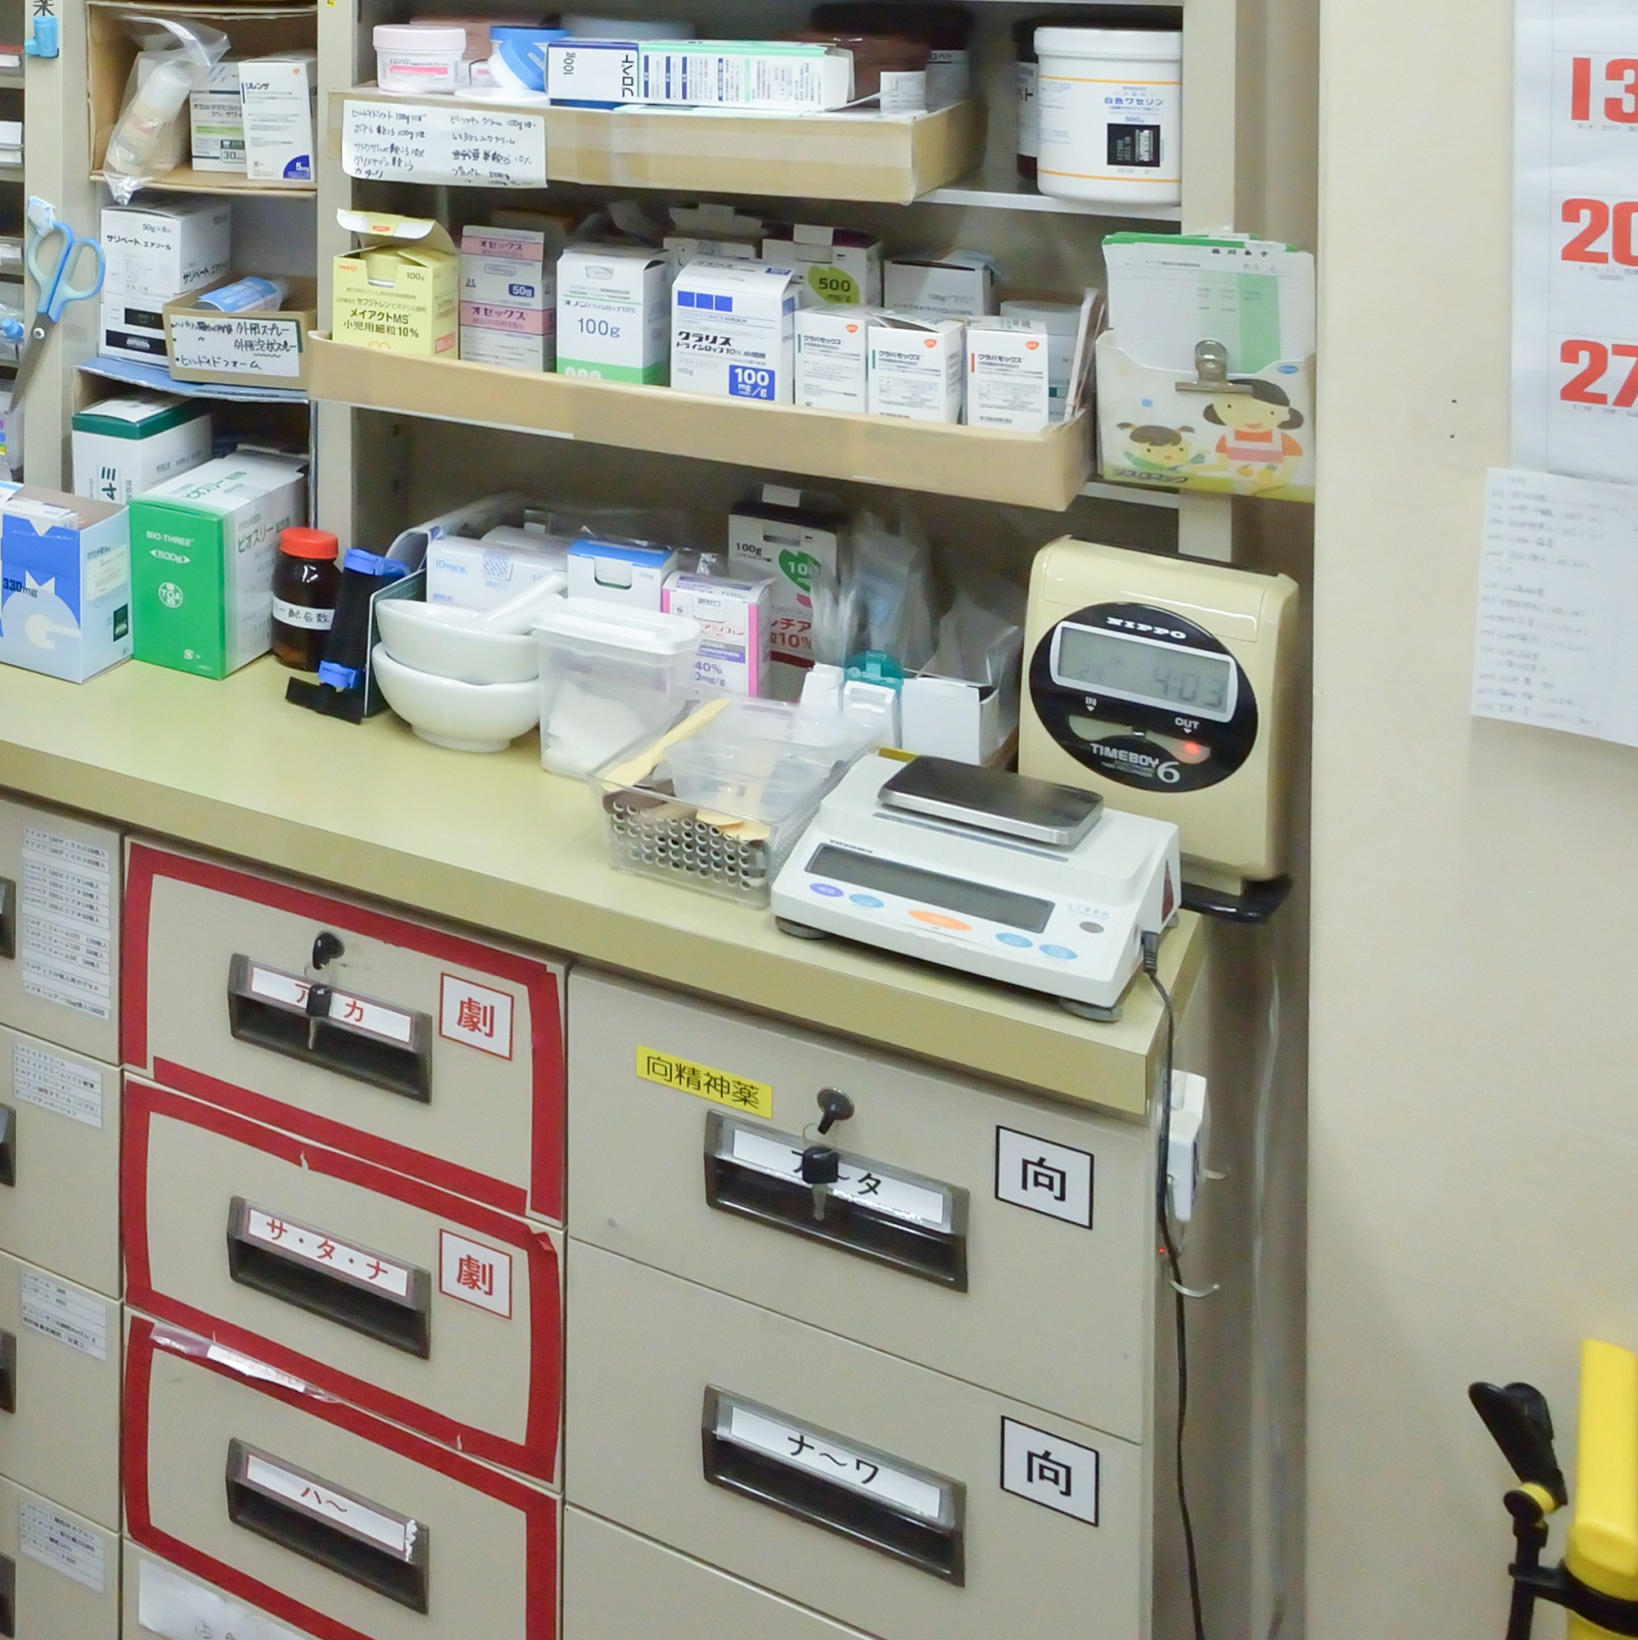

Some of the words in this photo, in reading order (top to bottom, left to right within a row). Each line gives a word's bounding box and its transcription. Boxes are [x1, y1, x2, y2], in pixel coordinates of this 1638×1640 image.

[563, 51, 575, 75] 100g
[245, 82, 269, 91] リレンザ
[1571, 57, 1638, 122] 13
[1105, 96, 1163, 106] 白色ワセリン
[510, 284, 533, 297] 50g
[819, 277, 851, 294] 500
[471, 306, 525, 321] オゼックス
[343, 319, 419, 338] 小児用細粒10%
[578, 317, 621, 338] 100g
[678, 331, 733, 346] クラリス
[734, 368, 769, 385] 100
[1559, 341, 1638, 406] 27
[146, 530, 195, 547] BIO-THREE
[3, 578, 37, 598] 330mg
[1106, 617, 1186, 640] NIPPO
[1153, 668, 1224, 709] 4:03
[1085, 697, 1097, 706] IN
[1175, 717, 1199, 730] OUT
[1090, 744, 1159, 768] TIMEBOY
[1157, 761, 1180, 783] 6
[457, 996, 494, 1038] 劇
[646, 1055, 759, 1109] 向精神薬
[1021, 1158, 1066, 1201] 向
[457, 1254, 494, 1296] 劇
[787, 1434, 880, 1484] ナ～ワ
[1027, 1450, 1071, 1496] 向
